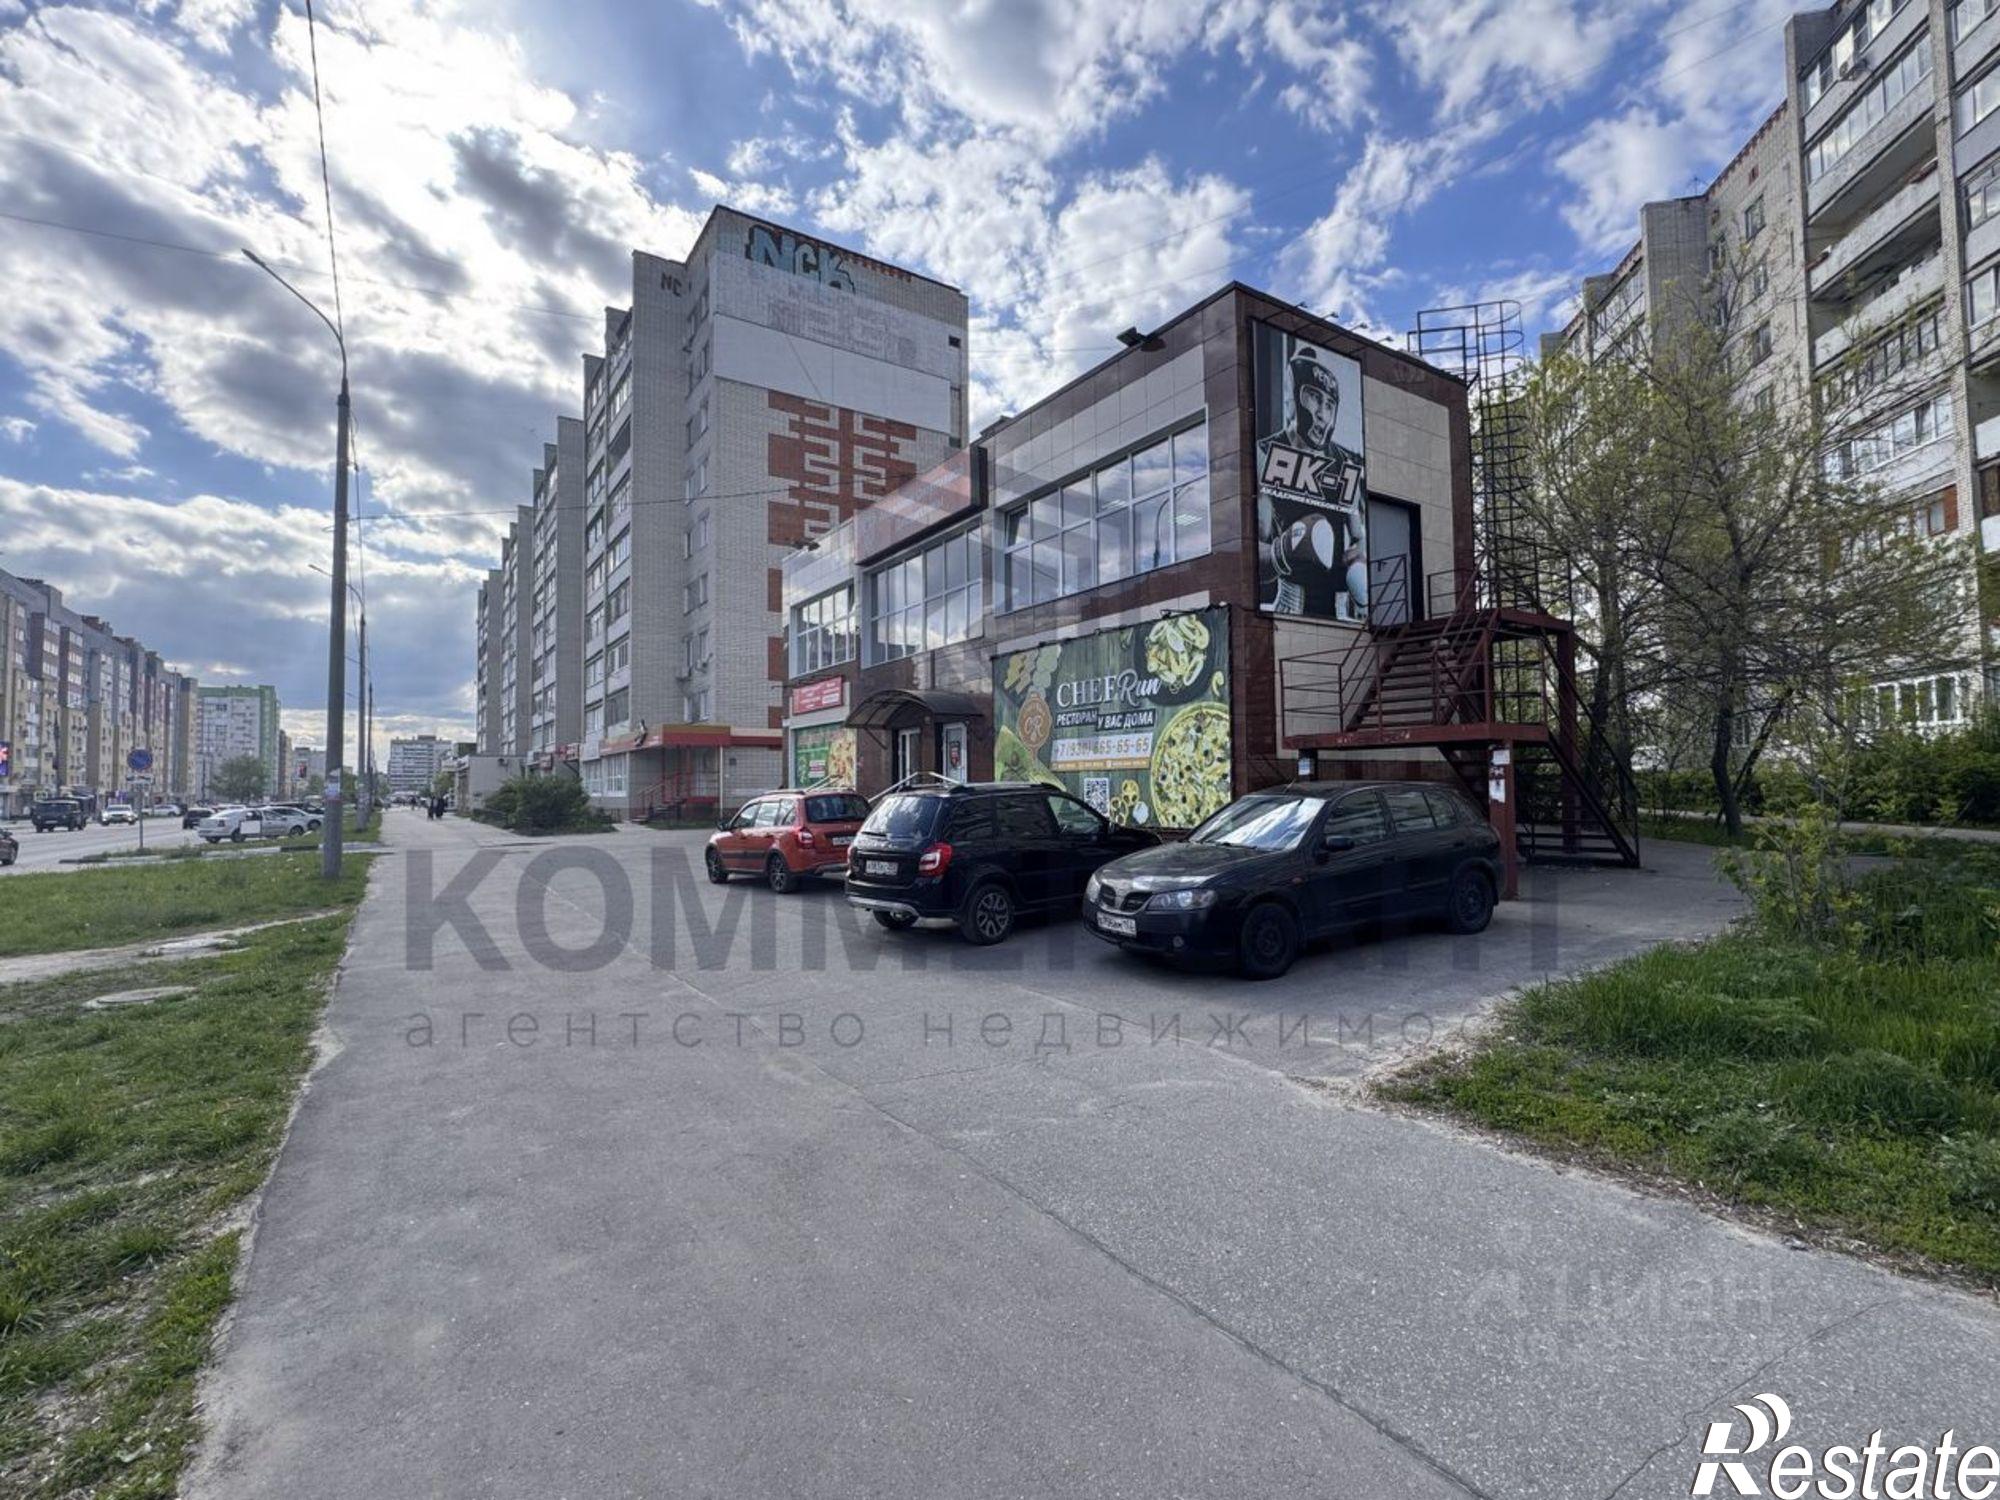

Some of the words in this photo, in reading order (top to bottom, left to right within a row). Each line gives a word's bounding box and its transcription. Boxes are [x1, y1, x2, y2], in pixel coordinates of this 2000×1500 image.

[1056, 675, 1117, 708] CHEF
[1116, 668, 1162, 707] Run
[1056, 710, 1098, 727] РЕСТОРАН
[1123, 711, 1154, 729] ДОМА
